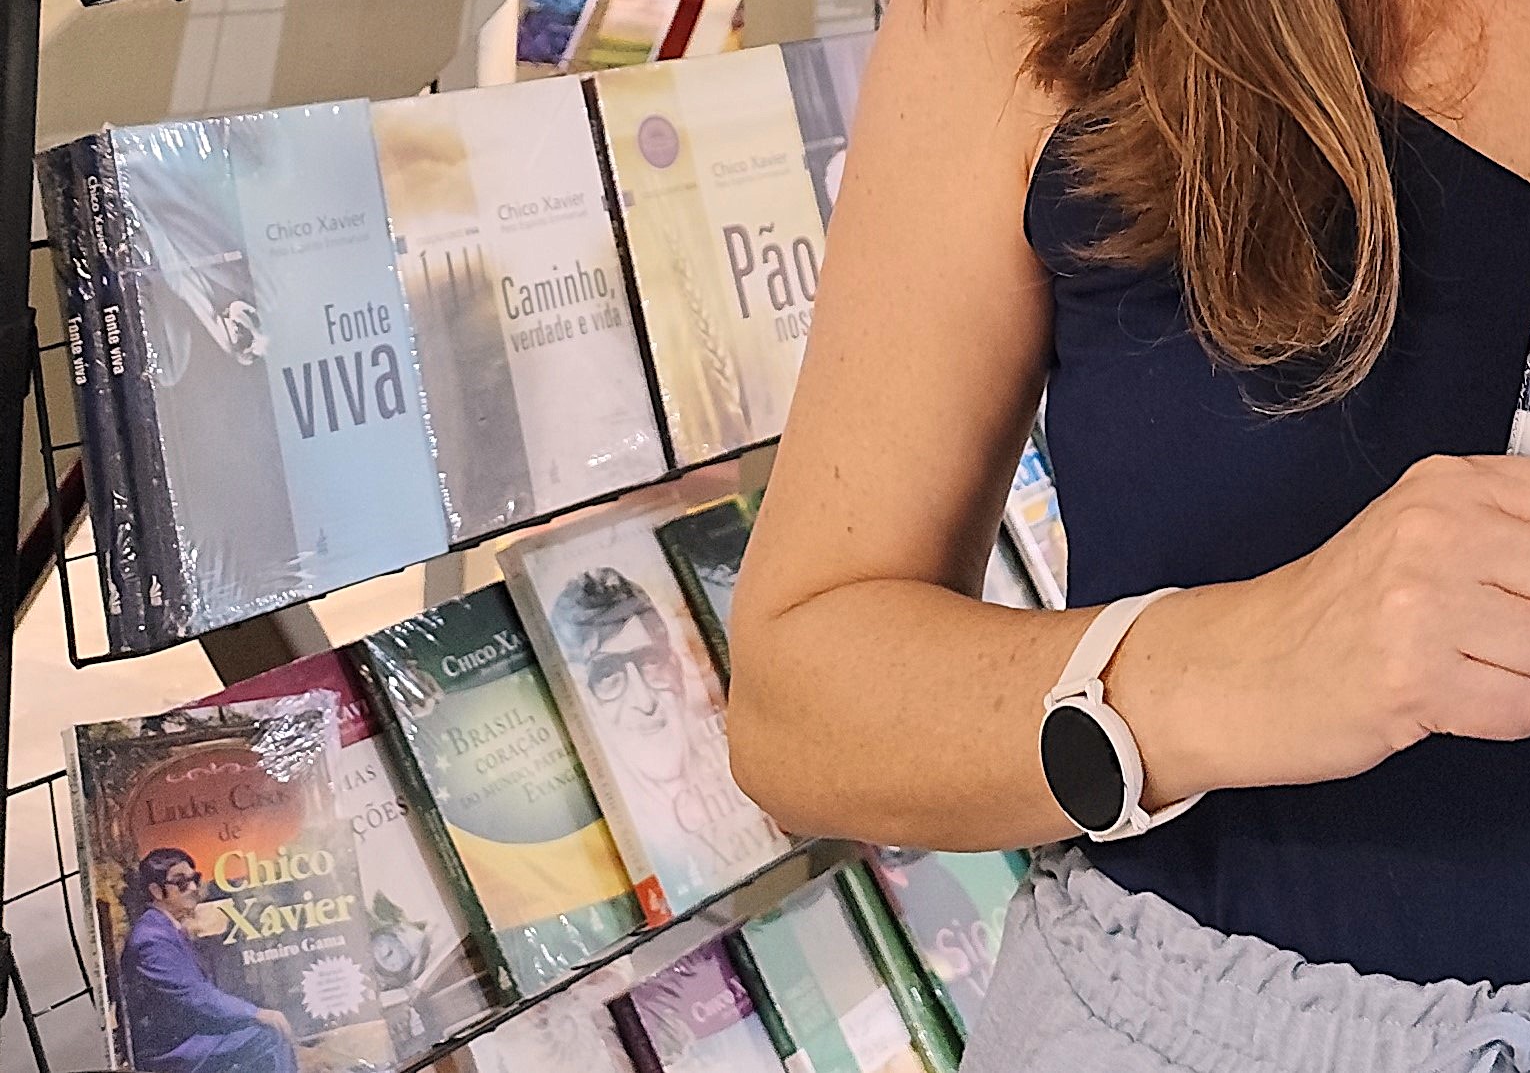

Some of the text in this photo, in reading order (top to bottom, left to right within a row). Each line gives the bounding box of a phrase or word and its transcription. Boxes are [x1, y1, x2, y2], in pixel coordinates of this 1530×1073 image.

[711, 152, 788, 178] Chico Xavier
[265, 212, 367, 242] Chico Xavier
[498, 202, 539, 221] Chico
[542, 191, 586, 213] Xavier
[501, 259, 617, 321] Caminho,
[722, 222, 821, 319] Pão
[103, 305, 128, 376] Fonte viva
[323, 301, 392, 345] Fonte
[510, 303, 623, 354] verdade e vida
[448, 709, 537, 756] BRASIL,
[476, 726, 551, 775] CORAÇÃO
[218, 822, 243, 842] de
[350, 795, 410, 843] ÇÕES
[214, 846, 336, 895] Chico
[216, 890, 356, 946] Xavier
[242, 934, 347, 967] Ramiro Gama
